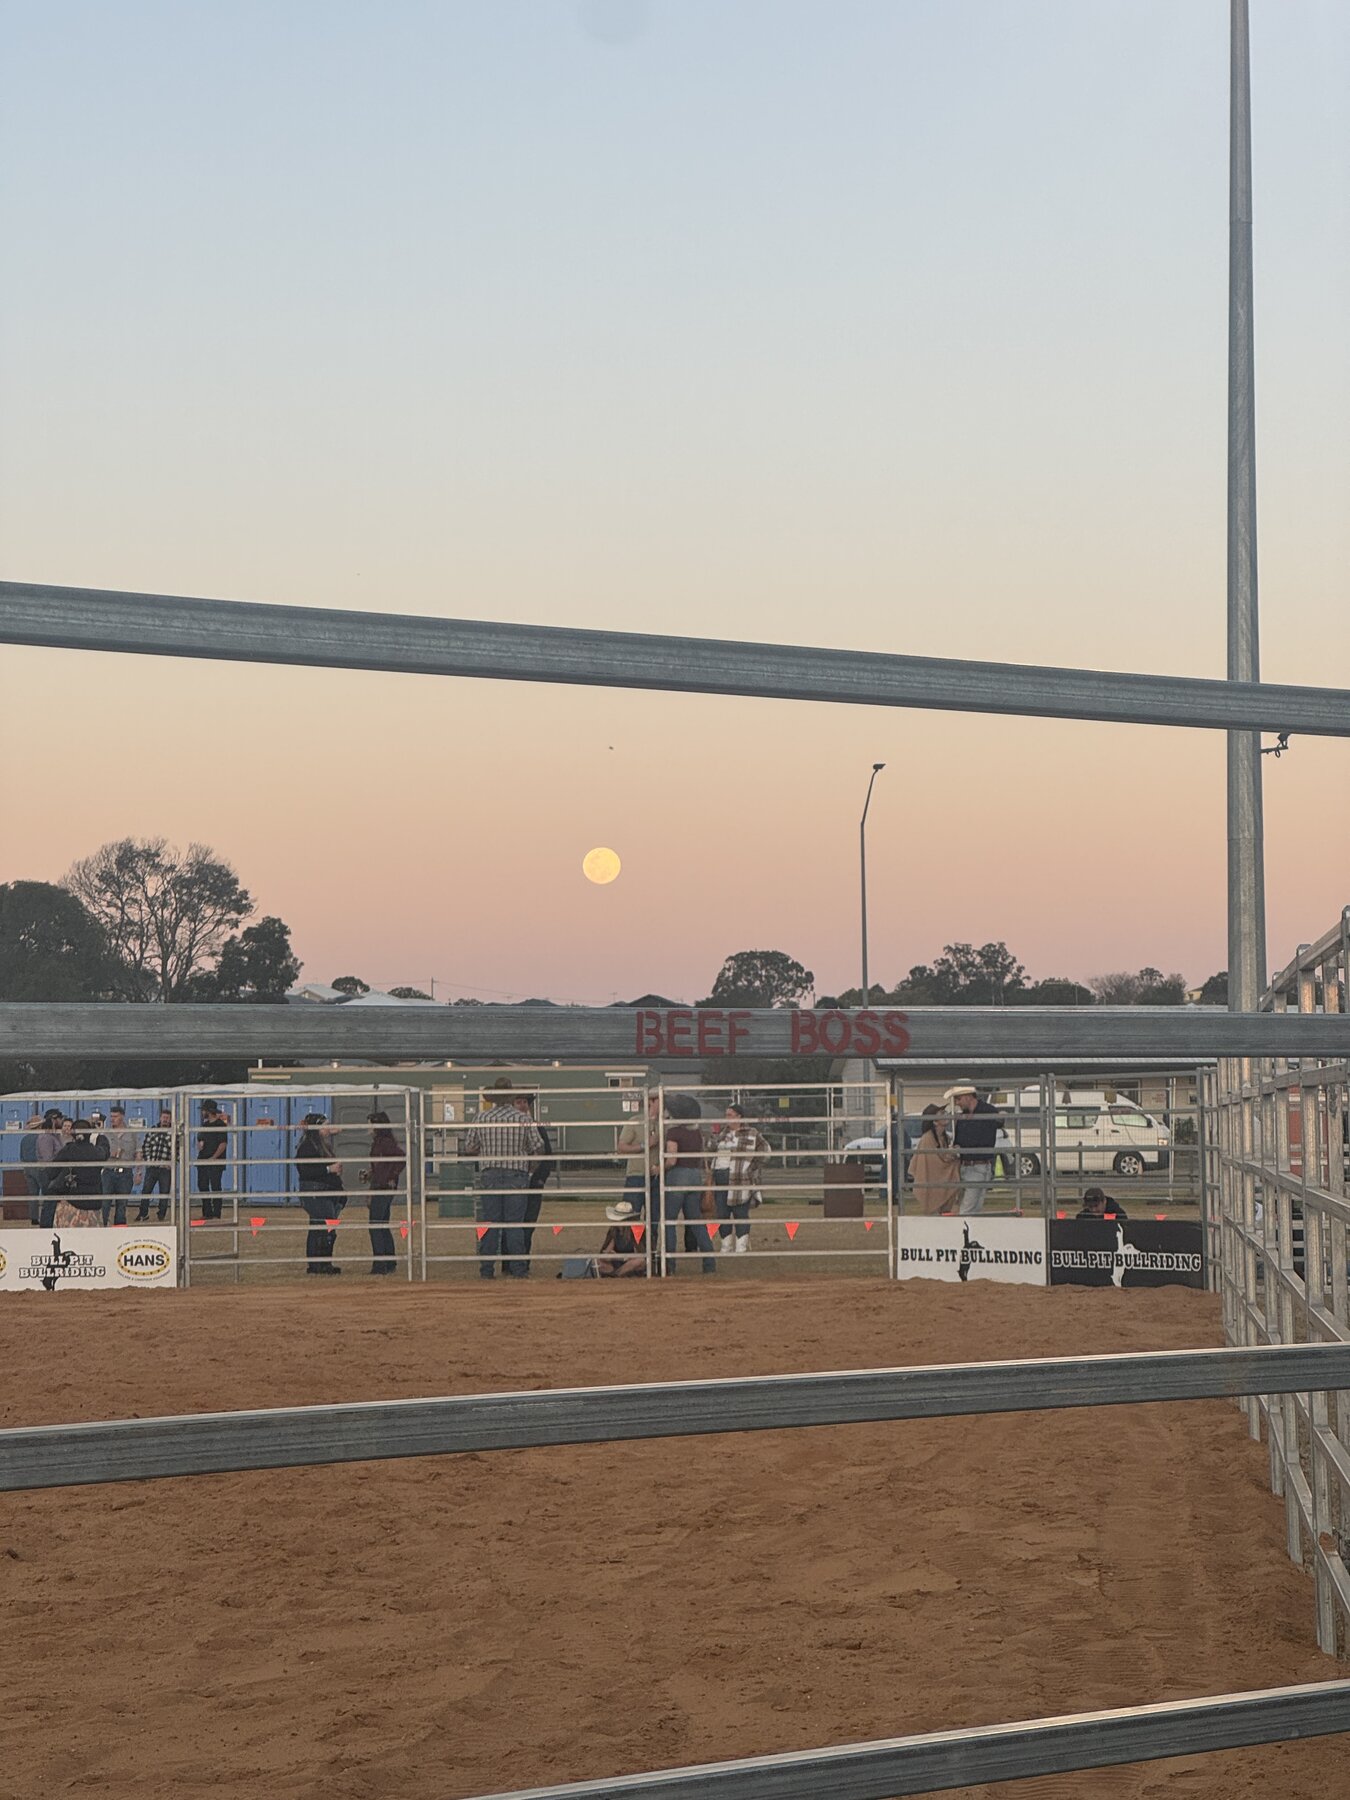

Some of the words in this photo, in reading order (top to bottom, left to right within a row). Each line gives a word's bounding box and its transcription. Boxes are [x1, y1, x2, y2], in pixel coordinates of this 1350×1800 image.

[637, 1010, 751, 1054] BEEF
[791, 1010, 911, 1054] BOSS
[31, 1255, 67, 1266] BULL
[69, 1254, 93, 1266] PIT
[124, 1254, 165, 1266] HANS
[901, 1248, 933, 1261] BULL
[936, 1249, 957, 1262] PIT
[961, 1250, 1042, 1264] BULLRIDING
[1052, 1251, 1087, 1267] BULL
[1088, 1251, 1112, 1268] PIT
[1114, 1252, 1201, 1271] BULLRIDING
[19, 1266, 106, 1278] BULLRIDING
